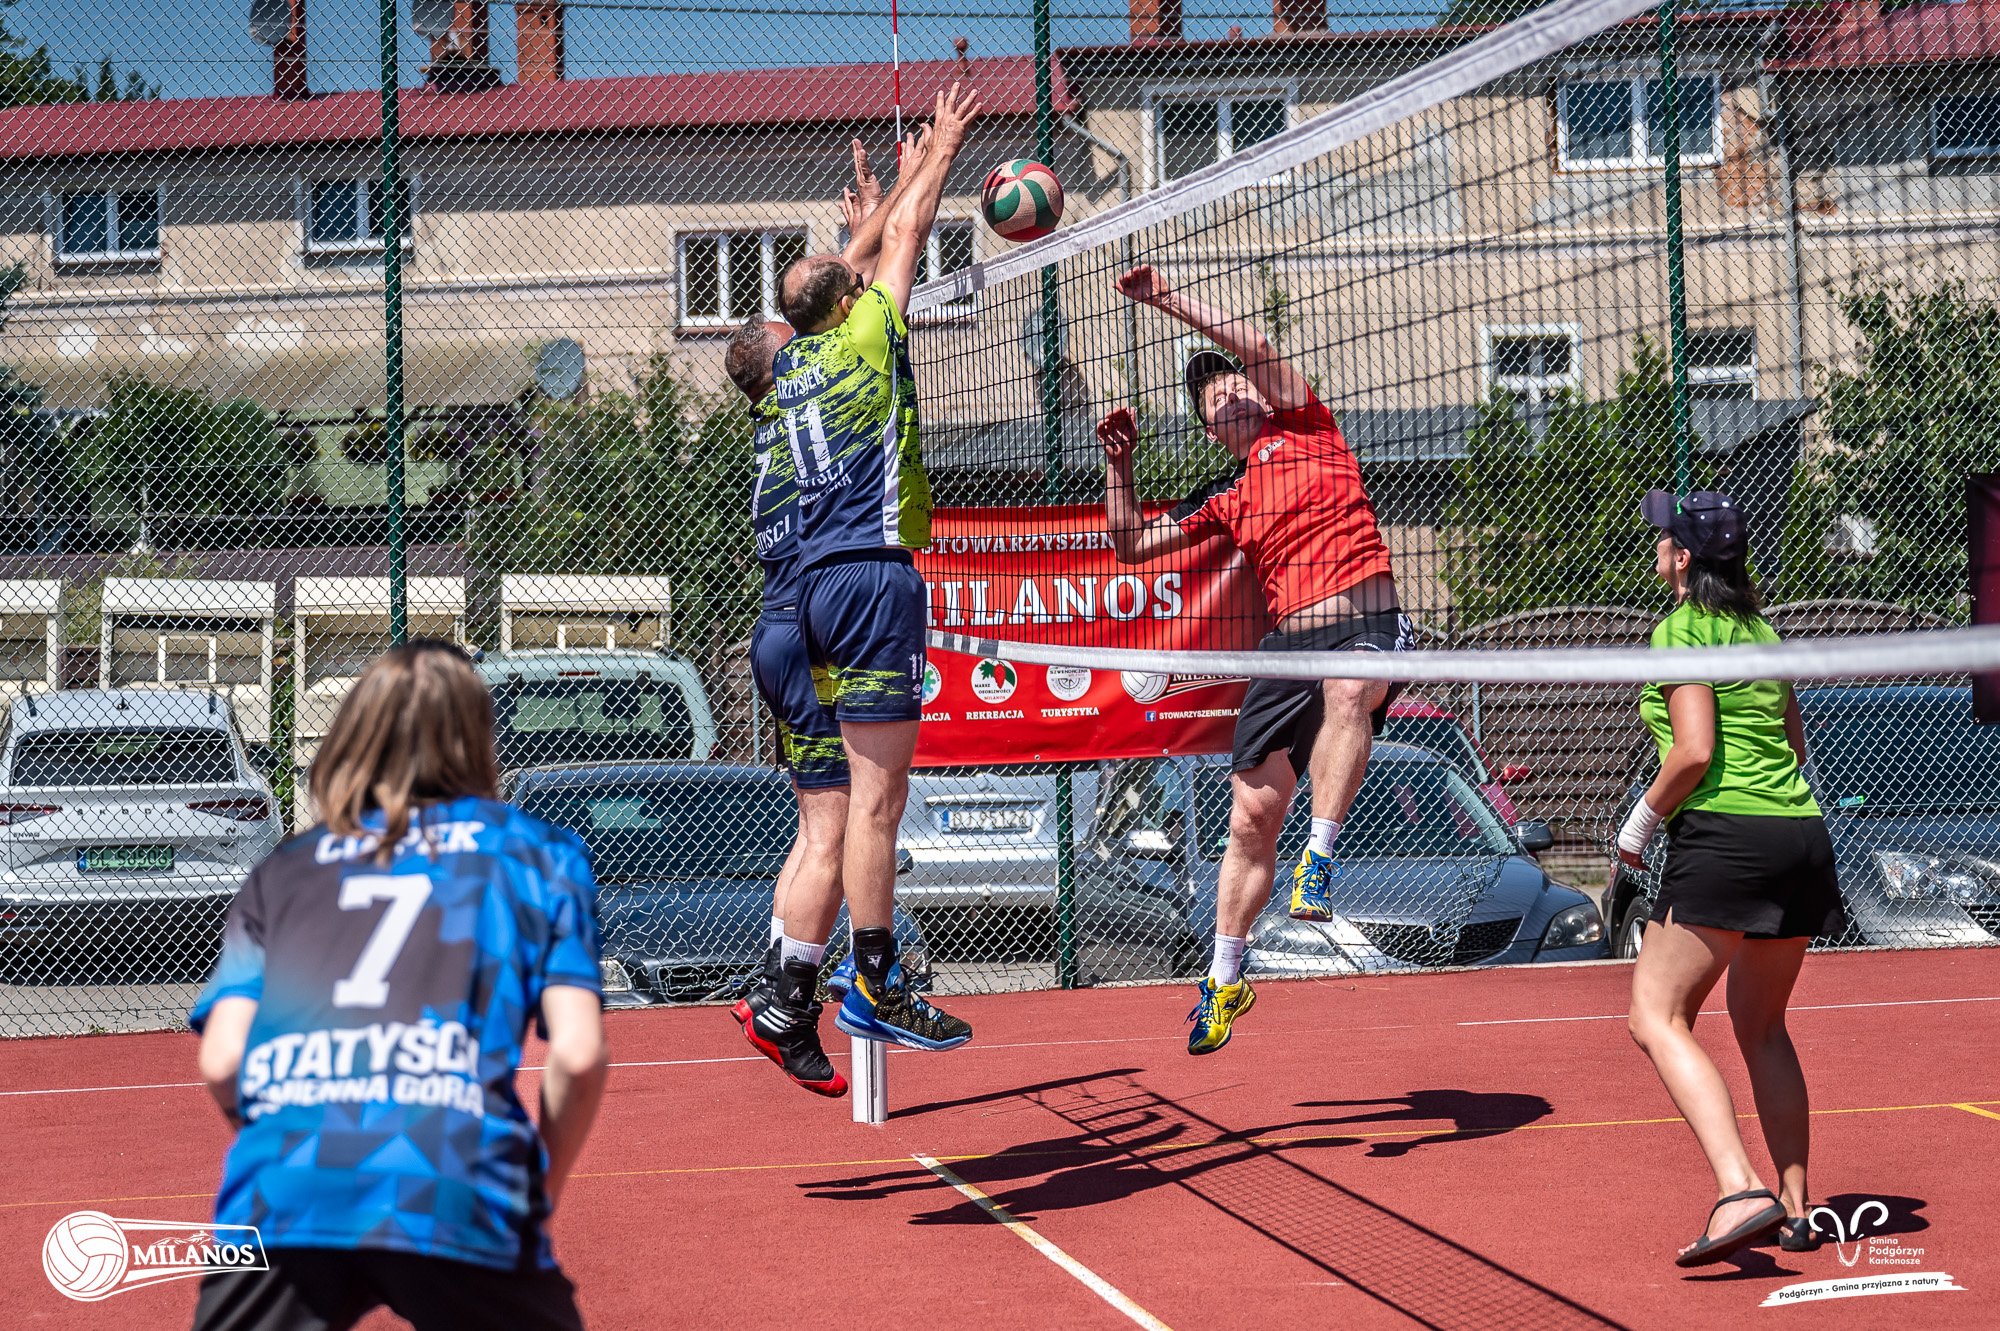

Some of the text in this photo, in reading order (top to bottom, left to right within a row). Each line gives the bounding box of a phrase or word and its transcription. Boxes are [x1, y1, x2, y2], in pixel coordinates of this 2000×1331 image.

[784, 402, 831, 480] 11
[753, 451, 772, 520] 7
[965, 709, 1025, 720] REKREACJA
[1041, 706, 1100, 718] TURYSTYKA
[333, 873, 433, 1008] 7
